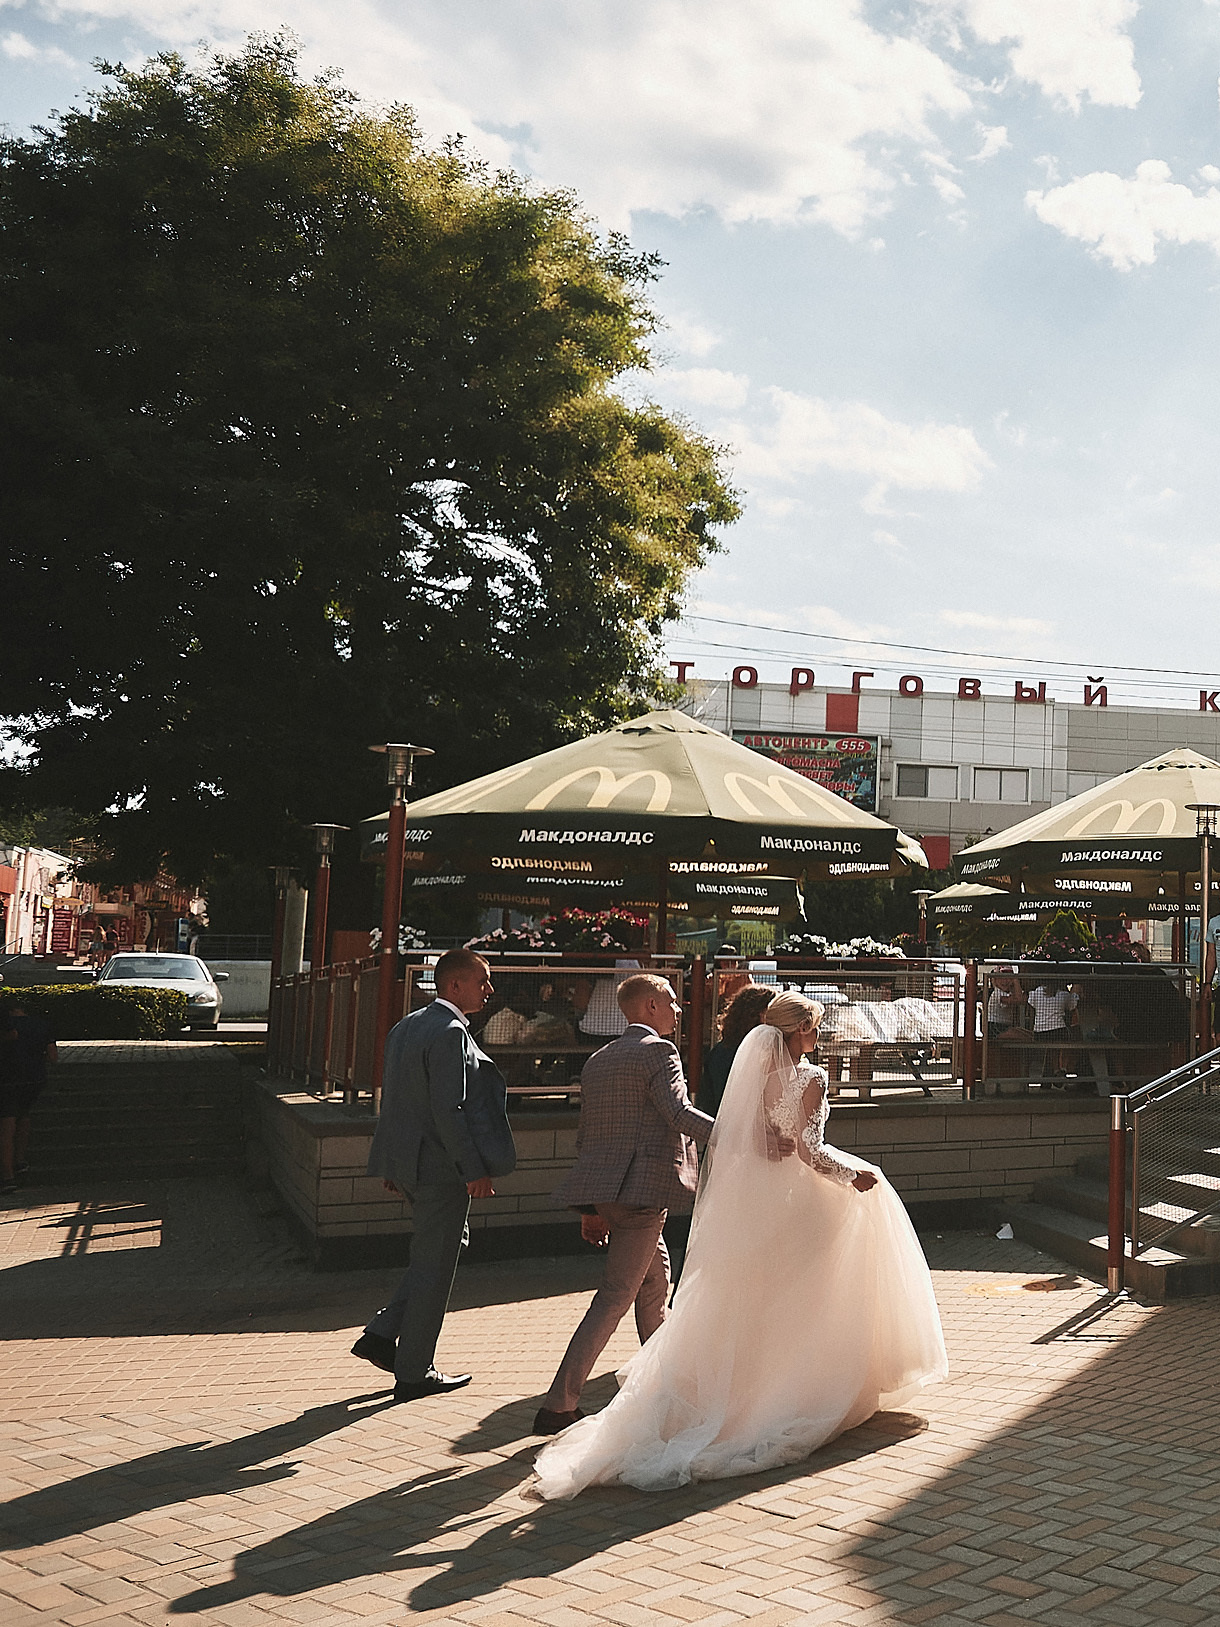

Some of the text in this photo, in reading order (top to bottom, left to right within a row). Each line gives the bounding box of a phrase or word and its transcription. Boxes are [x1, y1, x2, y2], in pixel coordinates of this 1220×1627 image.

[670, 661, 1108, 707] ТОРГОВЫЙ
[743, 735, 865, 751] АВТОЦЕНТР 555
[518, 829, 655, 845] Макдоналдс
[760, 835, 862, 855] Макдоналдс
[1060, 849, 1164, 863] Макдоналдс
[696, 883, 769, 897] Макдоналдс
[1018, 898, 1093, 912] Макдоналдс
